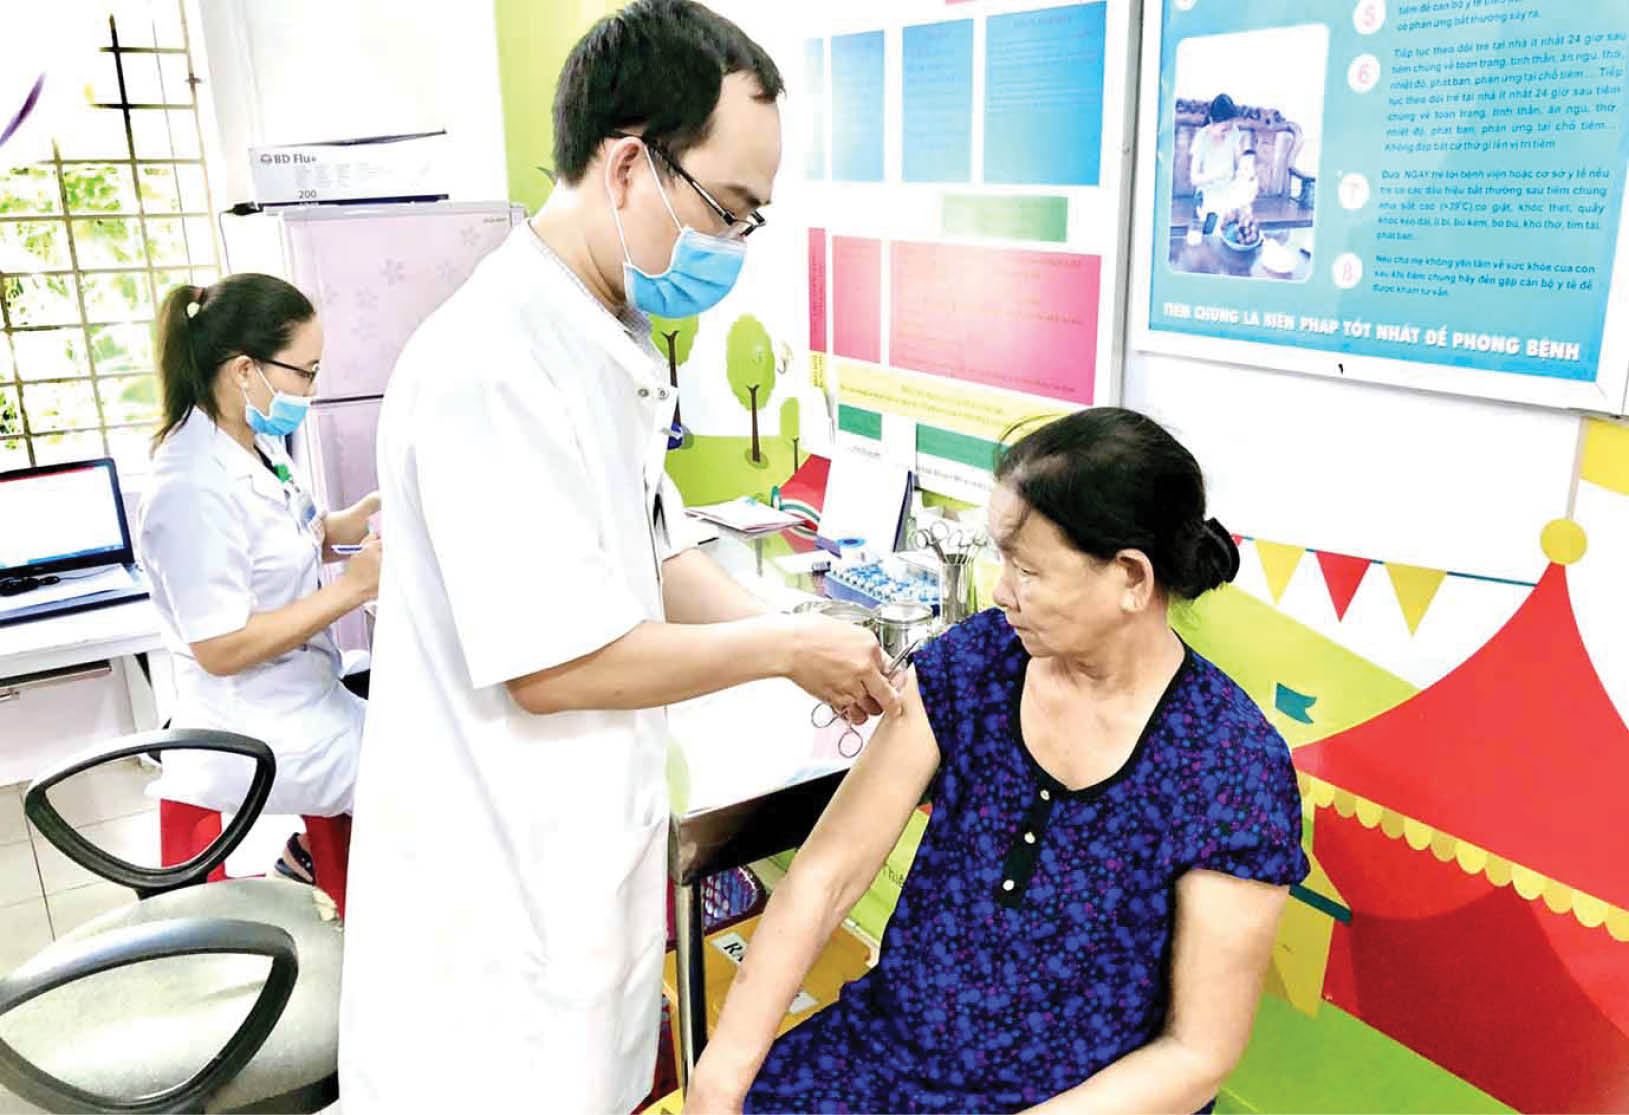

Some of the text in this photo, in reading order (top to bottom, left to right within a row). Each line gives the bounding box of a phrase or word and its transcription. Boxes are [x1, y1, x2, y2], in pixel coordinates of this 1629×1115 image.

[1364, 4, 1376, 27] 5
[1568, 34, 1580, 44] 24
[1357, 62, 1371, 84] 6
[1535, 88, 1547, 98] 24
[274, 153, 290, 164] BD
[298, 190, 317, 199] 200
[1343, 261, 1353, 281] 8
[1557, 281, 1564, 290] y
